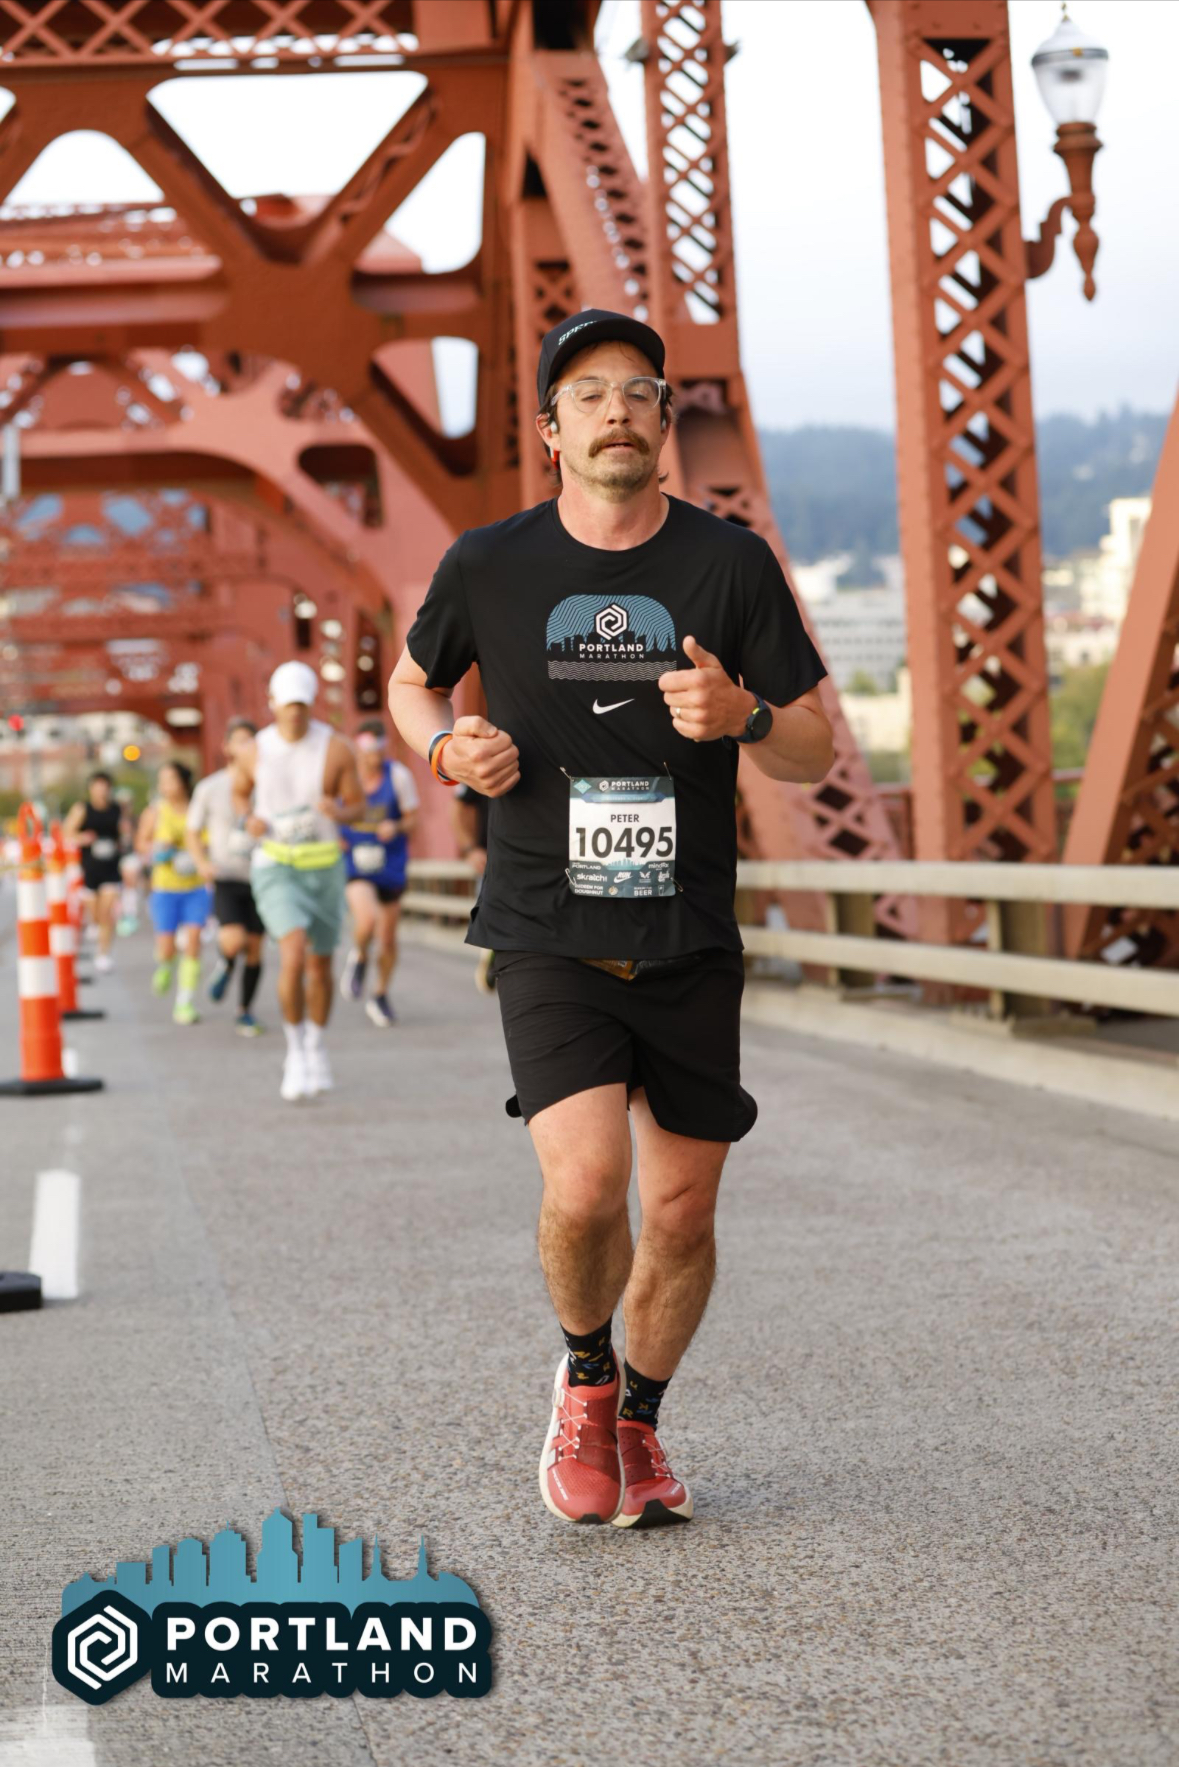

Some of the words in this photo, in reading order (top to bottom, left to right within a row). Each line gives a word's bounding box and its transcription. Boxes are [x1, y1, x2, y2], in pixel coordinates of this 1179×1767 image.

[579, 643, 644, 652] PORTLAND
[611, 814, 640, 823] PETER
[575, 826, 674, 859] 10495
[633, 889, 653, 897] BEER
